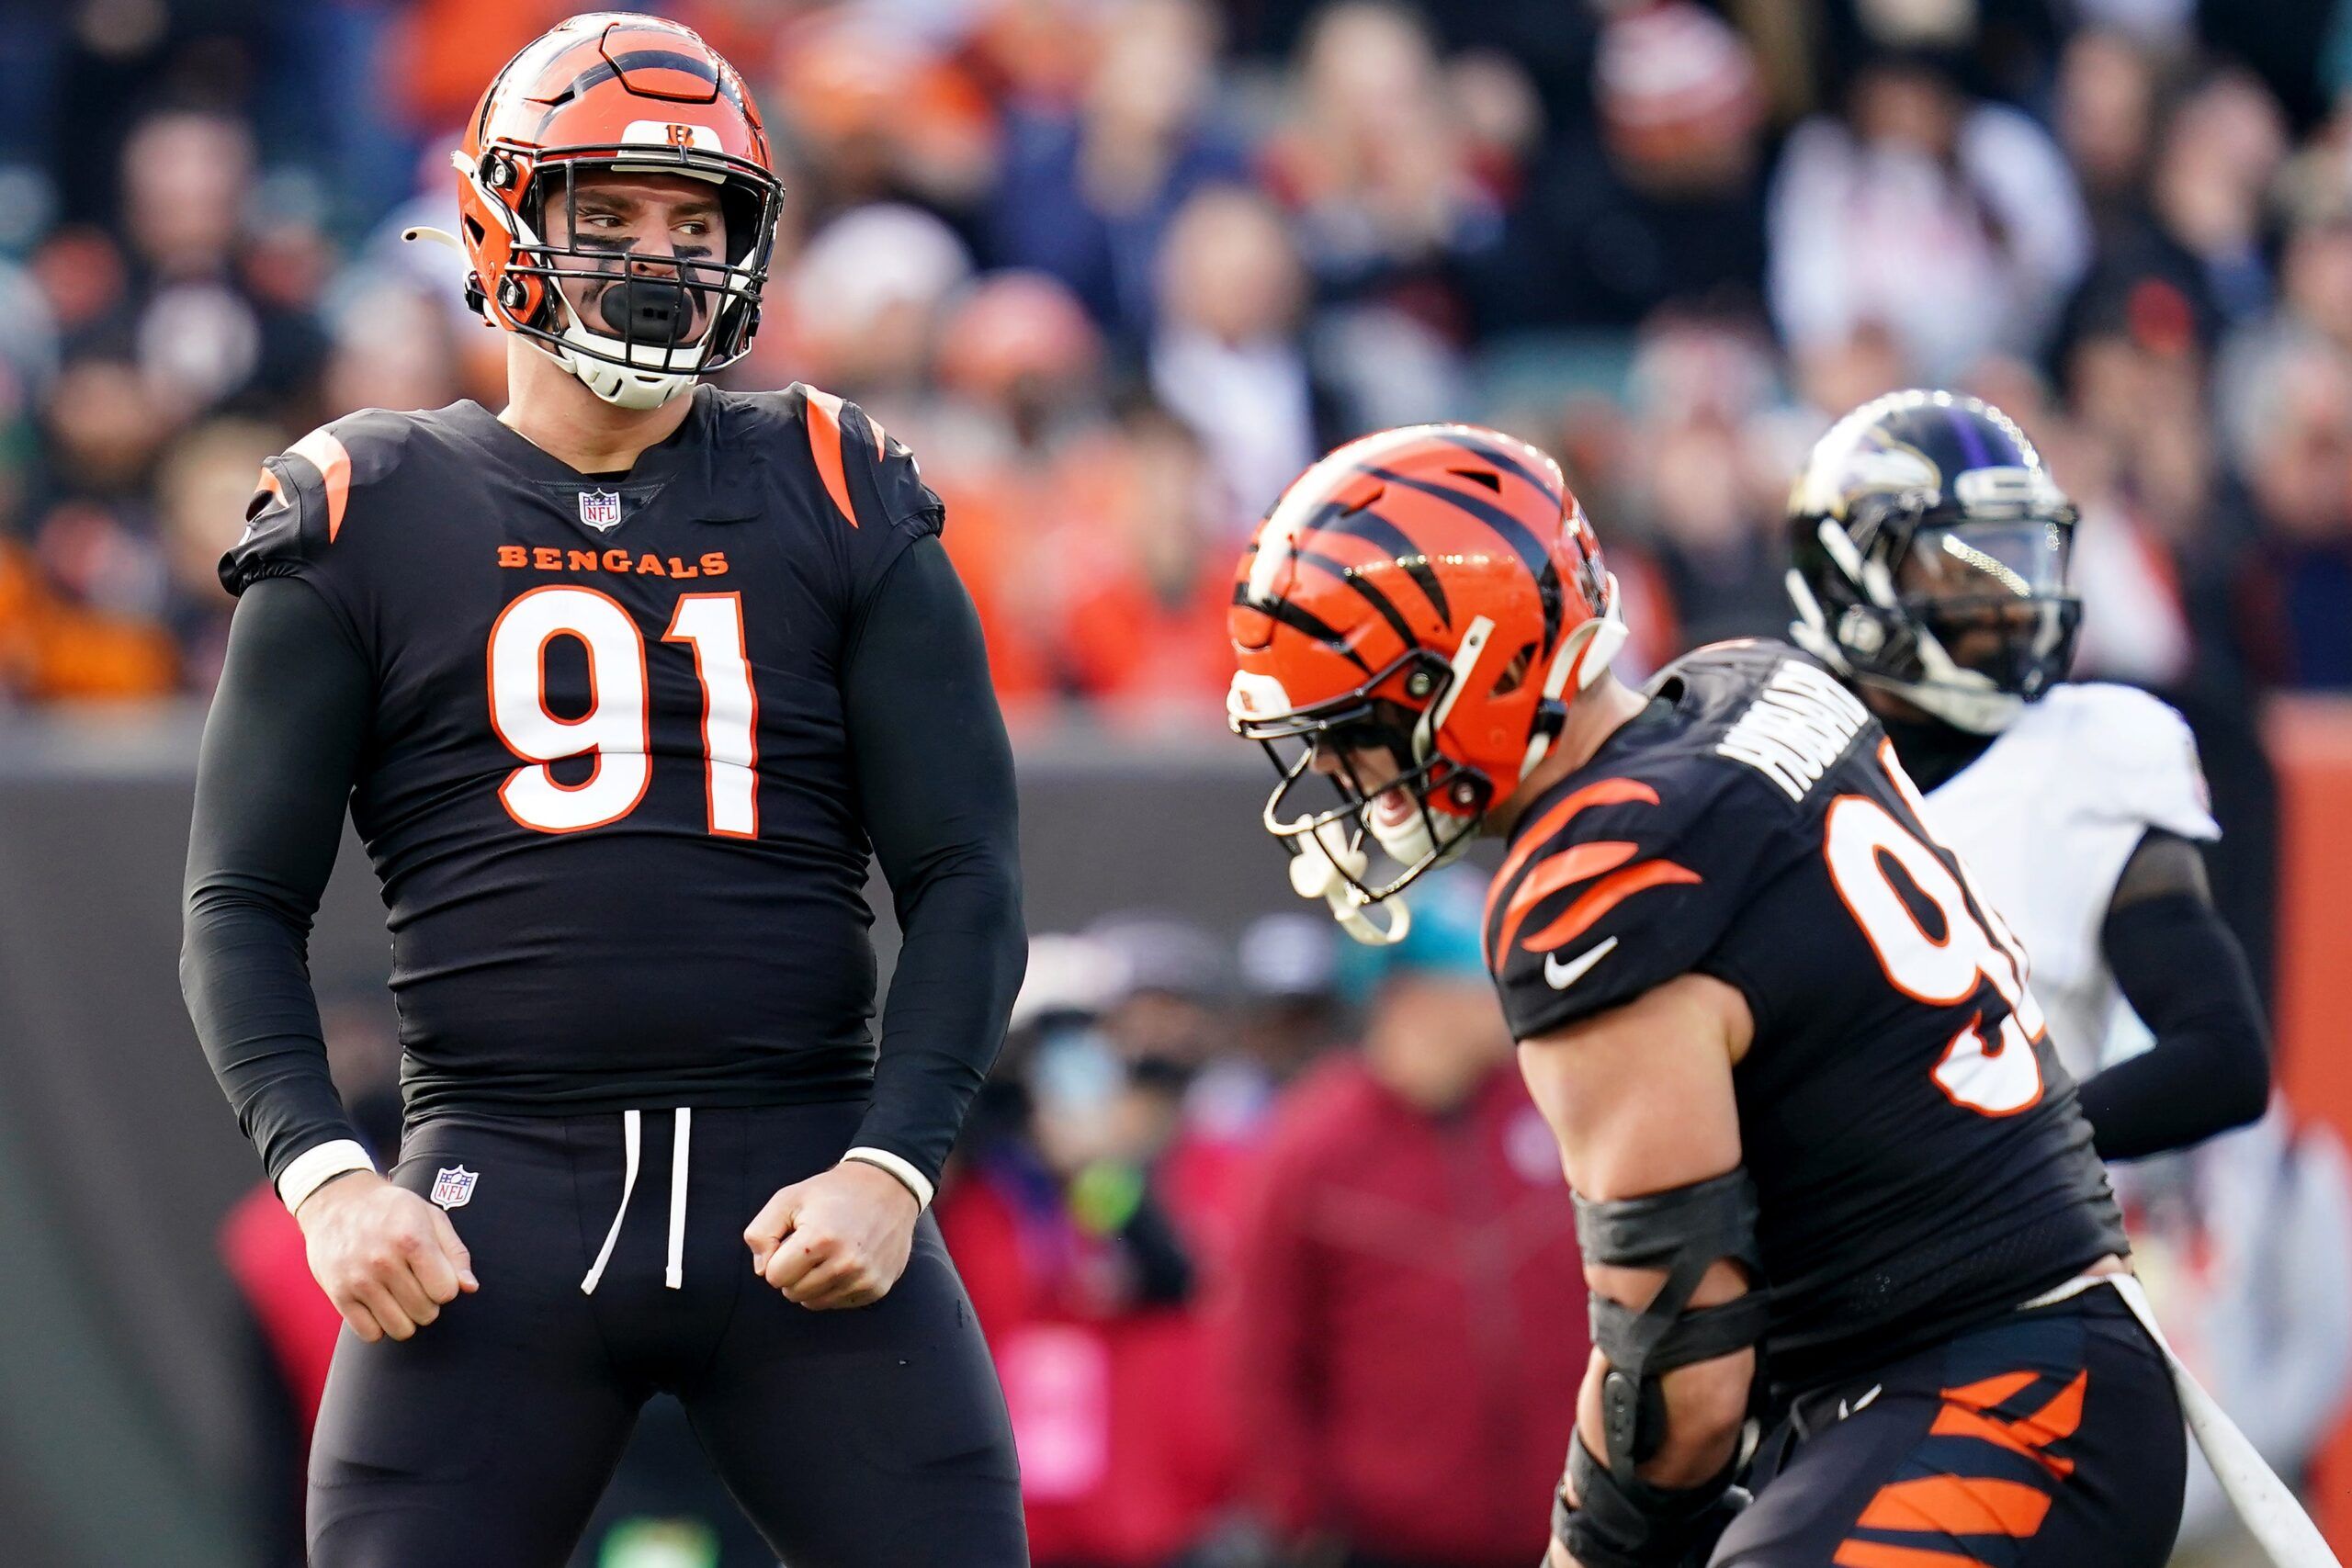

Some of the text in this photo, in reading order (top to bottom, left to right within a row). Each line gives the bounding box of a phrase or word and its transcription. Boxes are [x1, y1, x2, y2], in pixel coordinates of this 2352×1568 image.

[587, 506, 615, 522] NFL
[497, 546, 729, 579] BENGALS
[486, 584, 759, 840] 91
[437, 1184, 464, 1201] NFL
